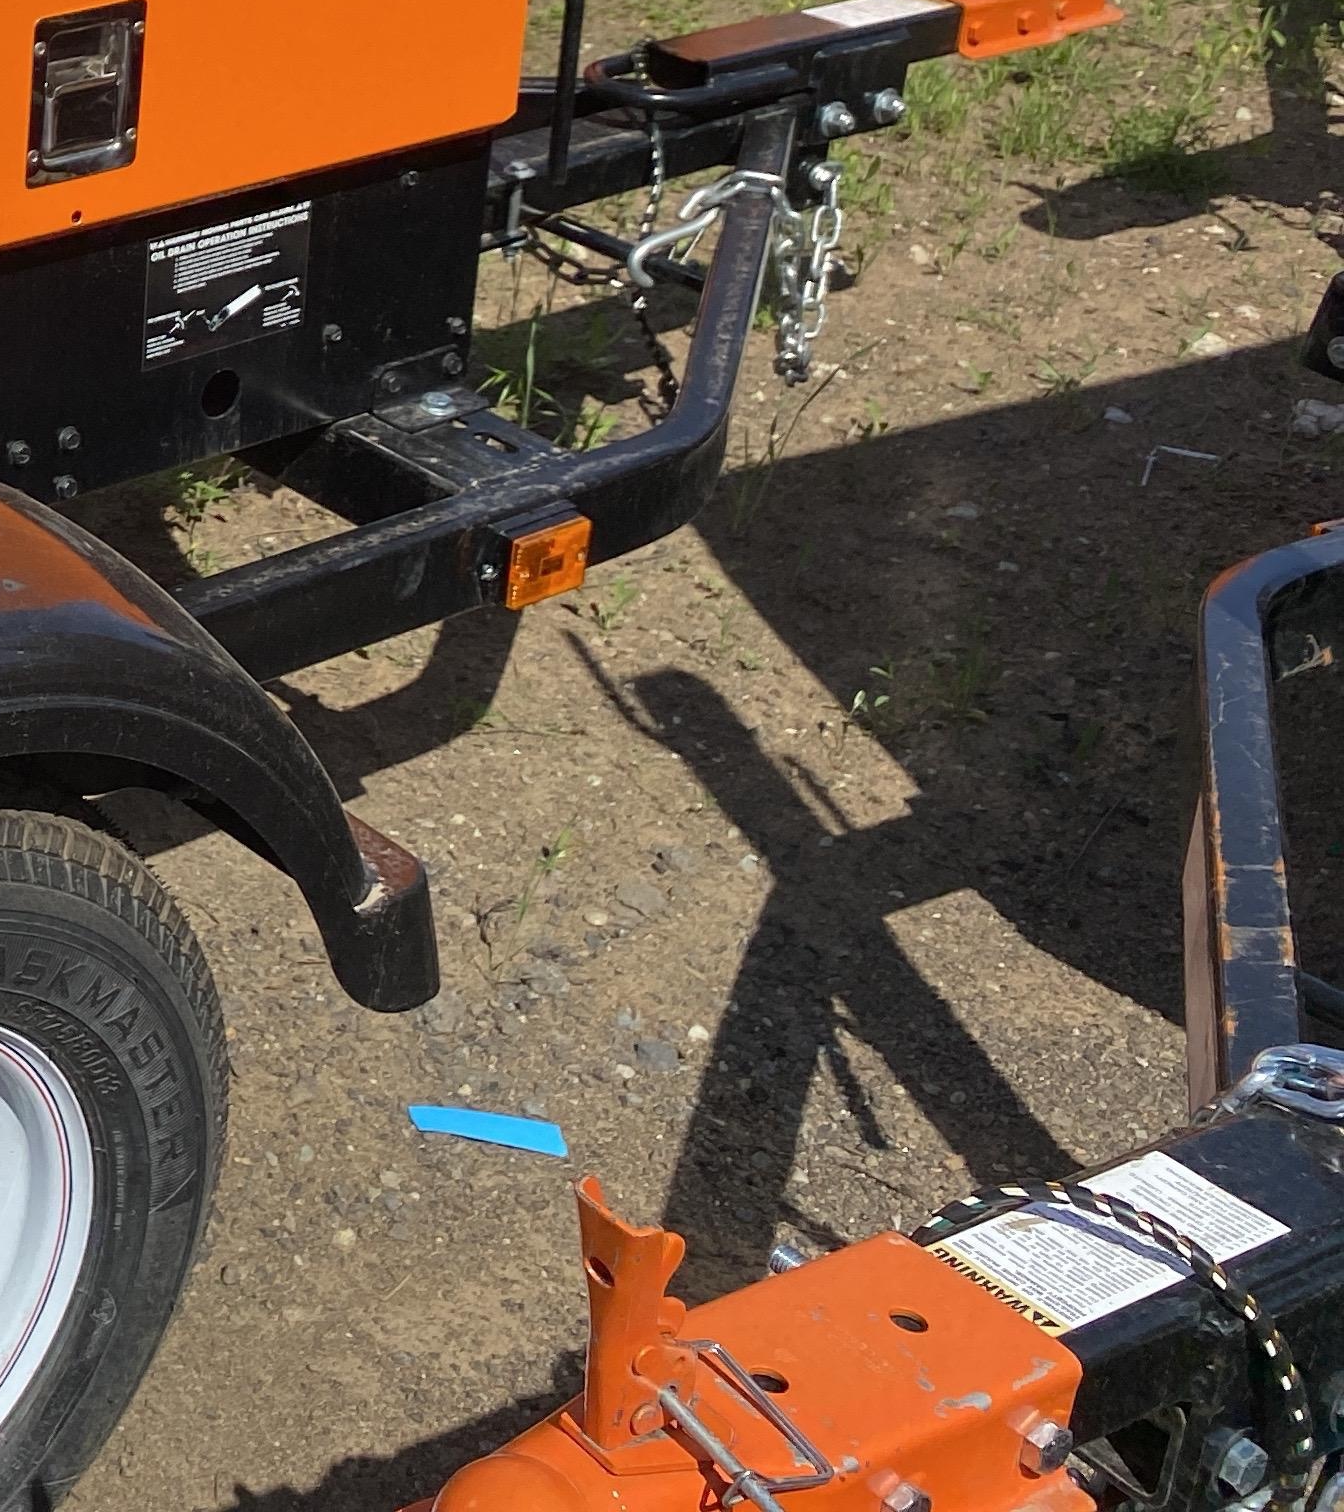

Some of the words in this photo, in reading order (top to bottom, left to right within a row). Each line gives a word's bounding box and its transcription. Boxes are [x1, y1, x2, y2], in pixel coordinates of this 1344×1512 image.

[167, 242, 197, 256] DRAIN
[197, 227, 247, 249] OPERATION
[248, 211, 309, 236] INSTRUCTIONS
